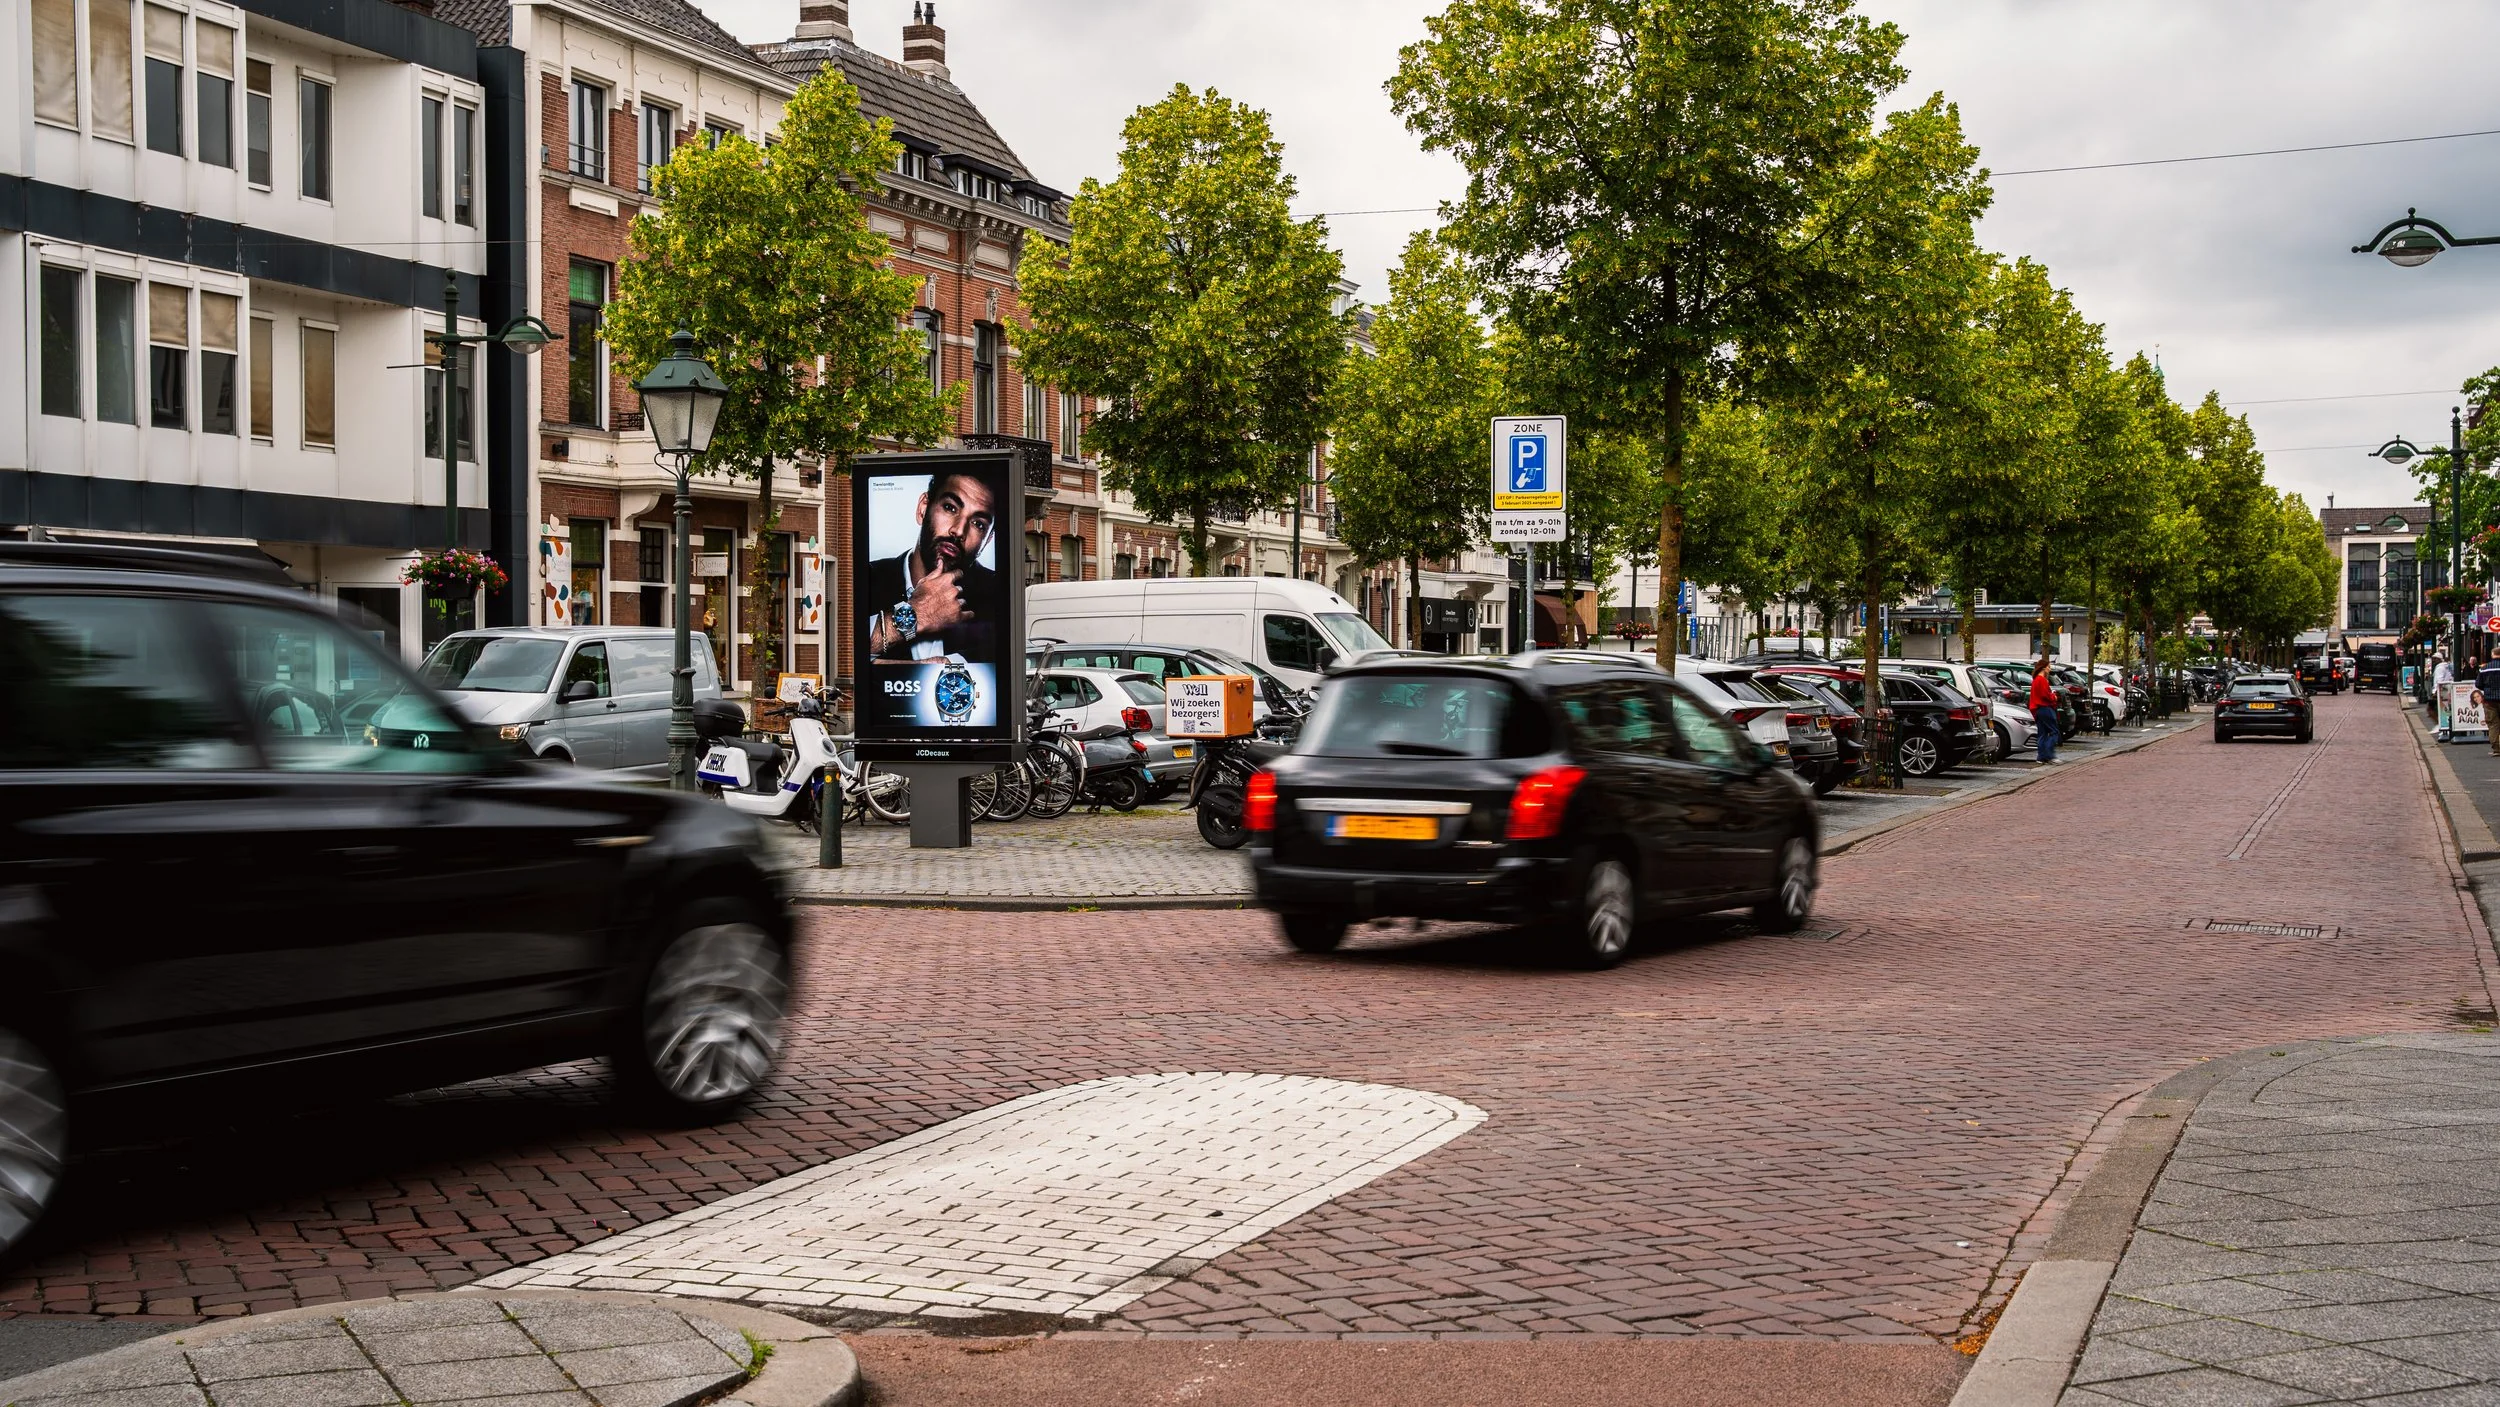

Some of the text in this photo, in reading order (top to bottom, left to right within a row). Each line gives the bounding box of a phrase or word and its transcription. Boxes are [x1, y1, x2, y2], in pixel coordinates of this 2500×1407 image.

[1514, 424, 1542, 432] ZONE
[1518, 441, 1538, 468] P
[1500, 528, 1528, 536] zondag
[884, 680, 921, 693] BOSS
[1182, 684, 1208, 696] Well
[1170, 699, 1221, 709] Wij zoeken
[1172, 709, 1220, 720] bezorgers!
[915, 749, 950, 757] JCDecaux
